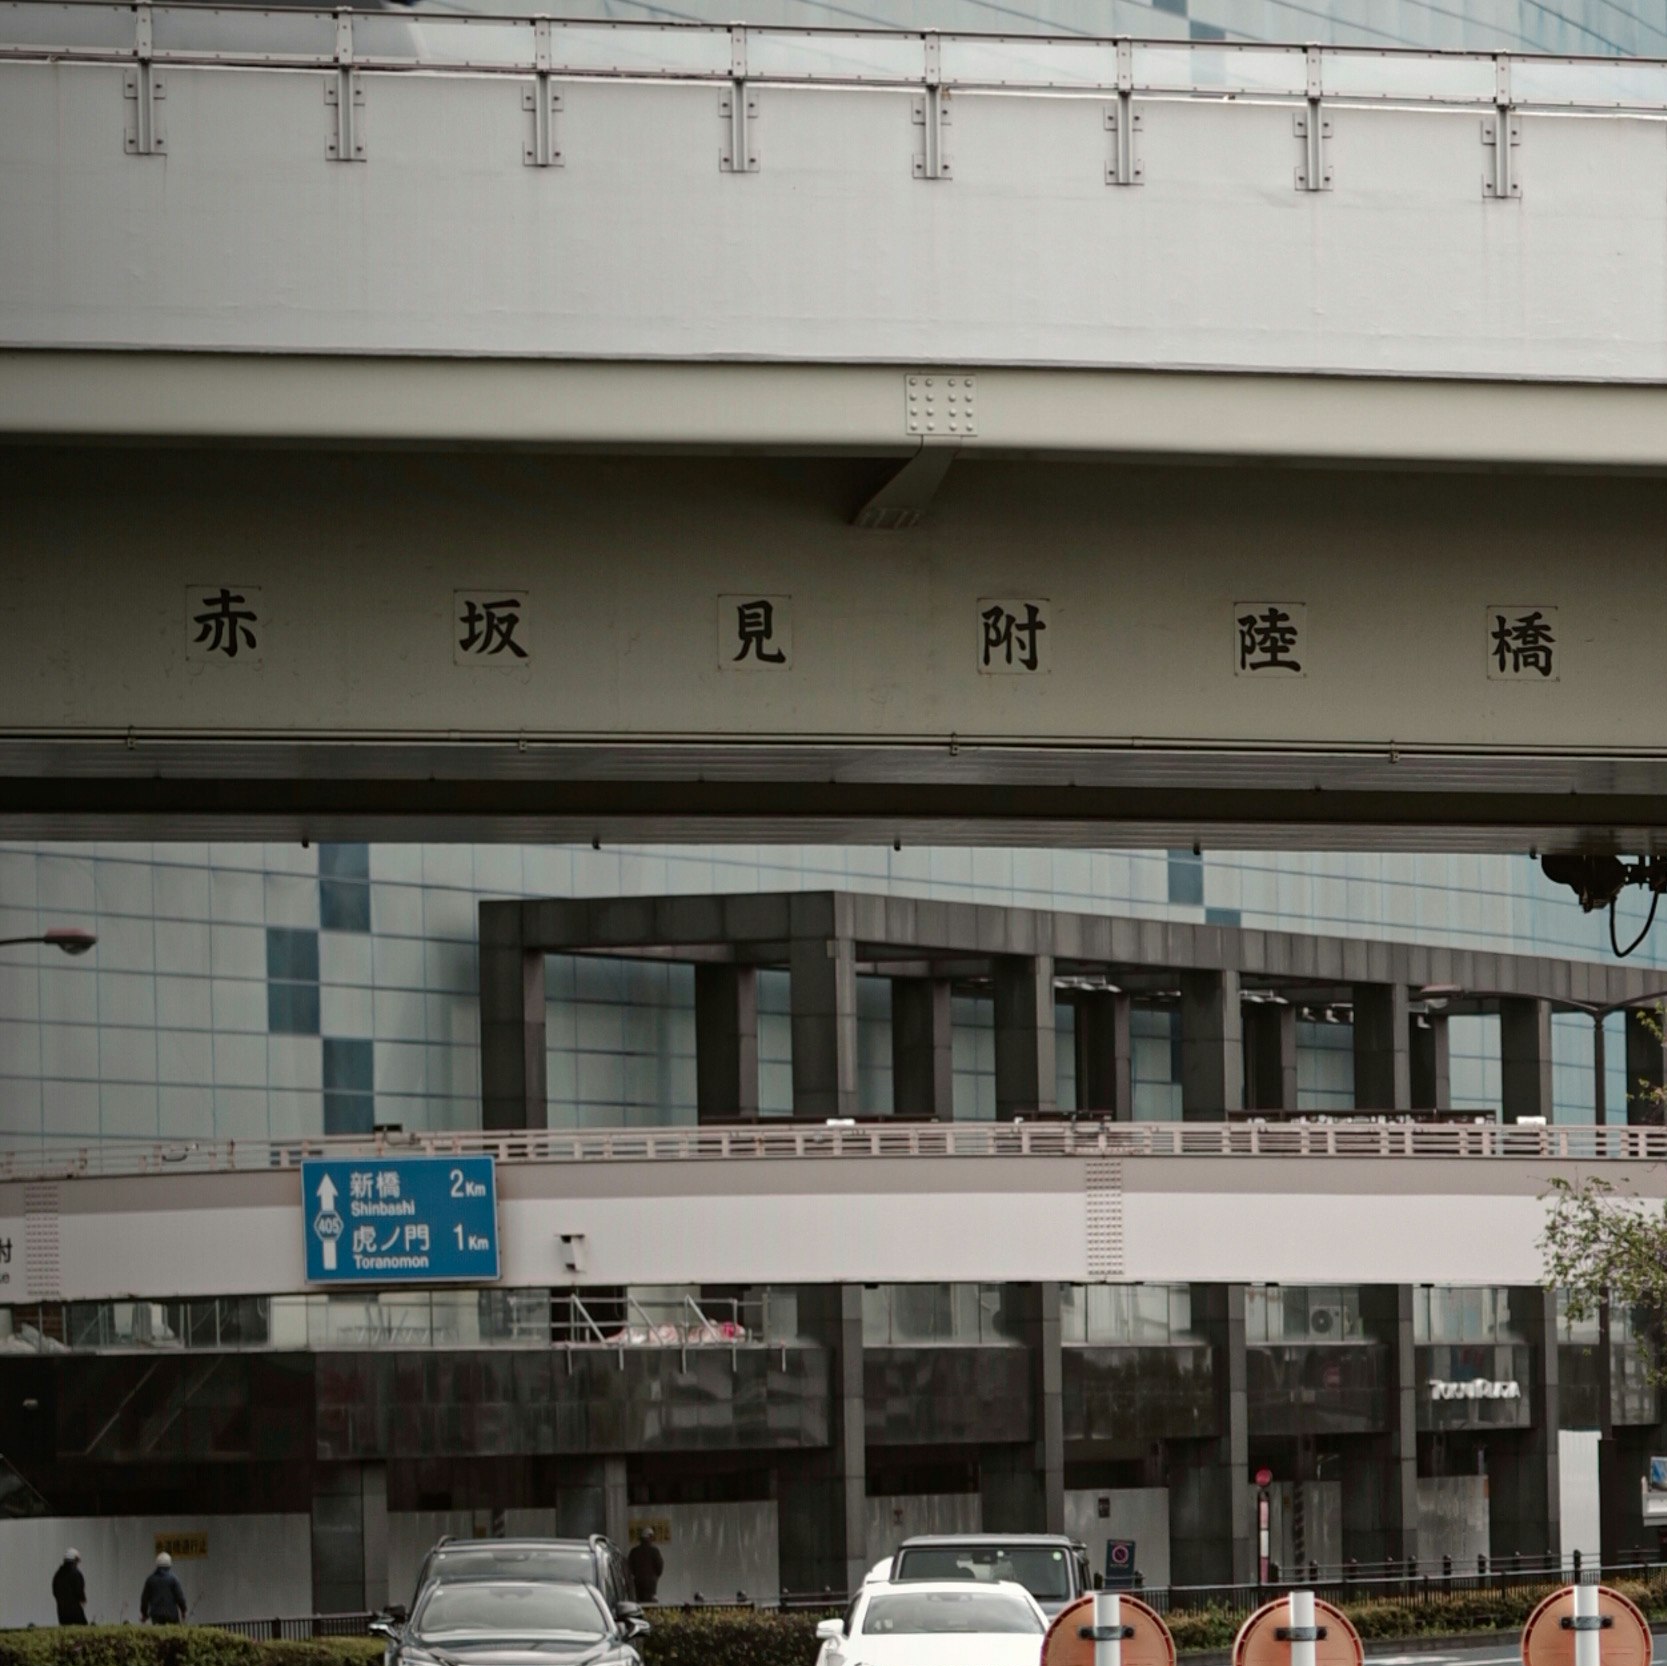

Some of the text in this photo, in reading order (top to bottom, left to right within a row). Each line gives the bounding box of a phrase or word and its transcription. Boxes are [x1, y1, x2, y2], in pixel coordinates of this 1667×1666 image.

[193, 588, 1556, 677] 赤坂見附陸橋
[350, 1170, 401, 1199] 新橋
[450, 1169, 486, 1198] 2 Km
[351, 1200, 415, 1217] Shinbashi
[318, 1217, 339, 1234] 405
[352, 1223, 430, 1253] 虎ノ門
[453, 1223, 489, 1251] 1 Km
[352, 1254, 430, 1270] Toranomon
